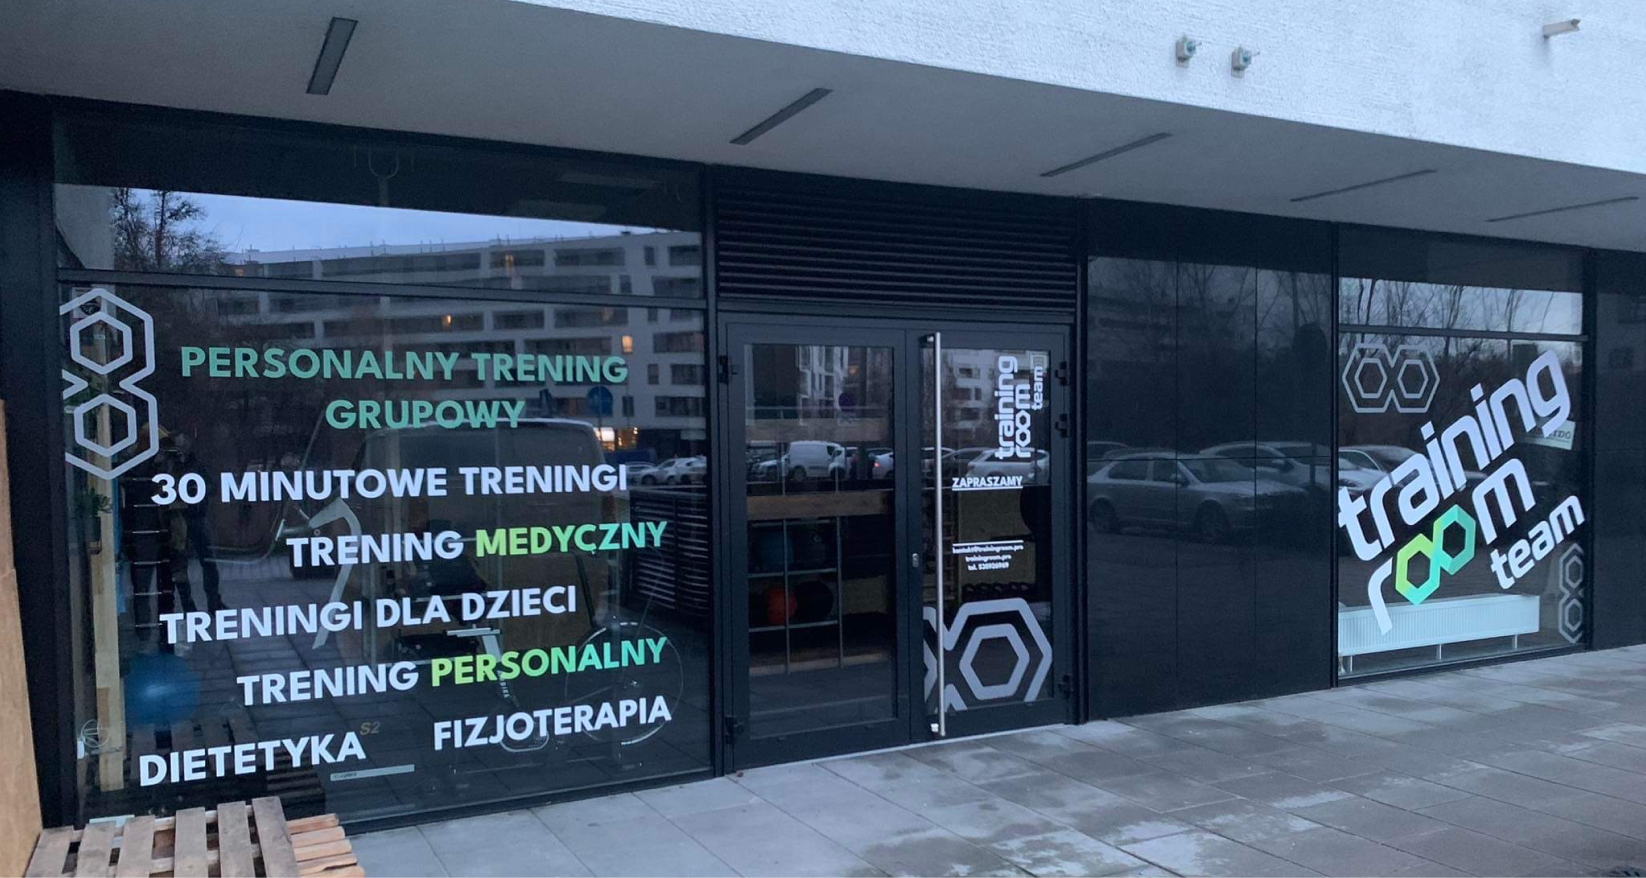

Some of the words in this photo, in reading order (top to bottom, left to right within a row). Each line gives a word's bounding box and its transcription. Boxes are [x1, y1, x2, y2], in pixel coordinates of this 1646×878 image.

[182, 347, 458, 380] PERSONALNY
[471, 353, 629, 383] TRENING
[1031, 366, 1043, 411] team
[326, 400, 525, 429] GRUPOWY
[994, 355, 1018, 459] training
[1015, 383, 1031, 458] room
[952, 475, 1023, 489] ZAPRASZAMY
[1338, 351, 1572, 561] training
[152, 473, 205, 504] 30
[221, 468, 446, 502] MINUTOWE
[459, 464, 628, 494] TRENINGI
[287, 532, 463, 567] TRENING
[477, 522, 667, 556] MEDYCZNY
[1368, 458, 1536, 636] room
[1491, 495, 1586, 589] team
[160, 603, 363, 643] TRENINGI
[377, 596, 450, 627] DLA
[462, 586, 575, 620] DZIECI
[237, 661, 418, 705] TRENING
[432, 637, 667, 686] PERSONALNY
[360, 721, 380, 735] S2
[435, 696, 671, 749] FIZJOTERAPIA
[140, 731, 367, 785] DIETETYKA
